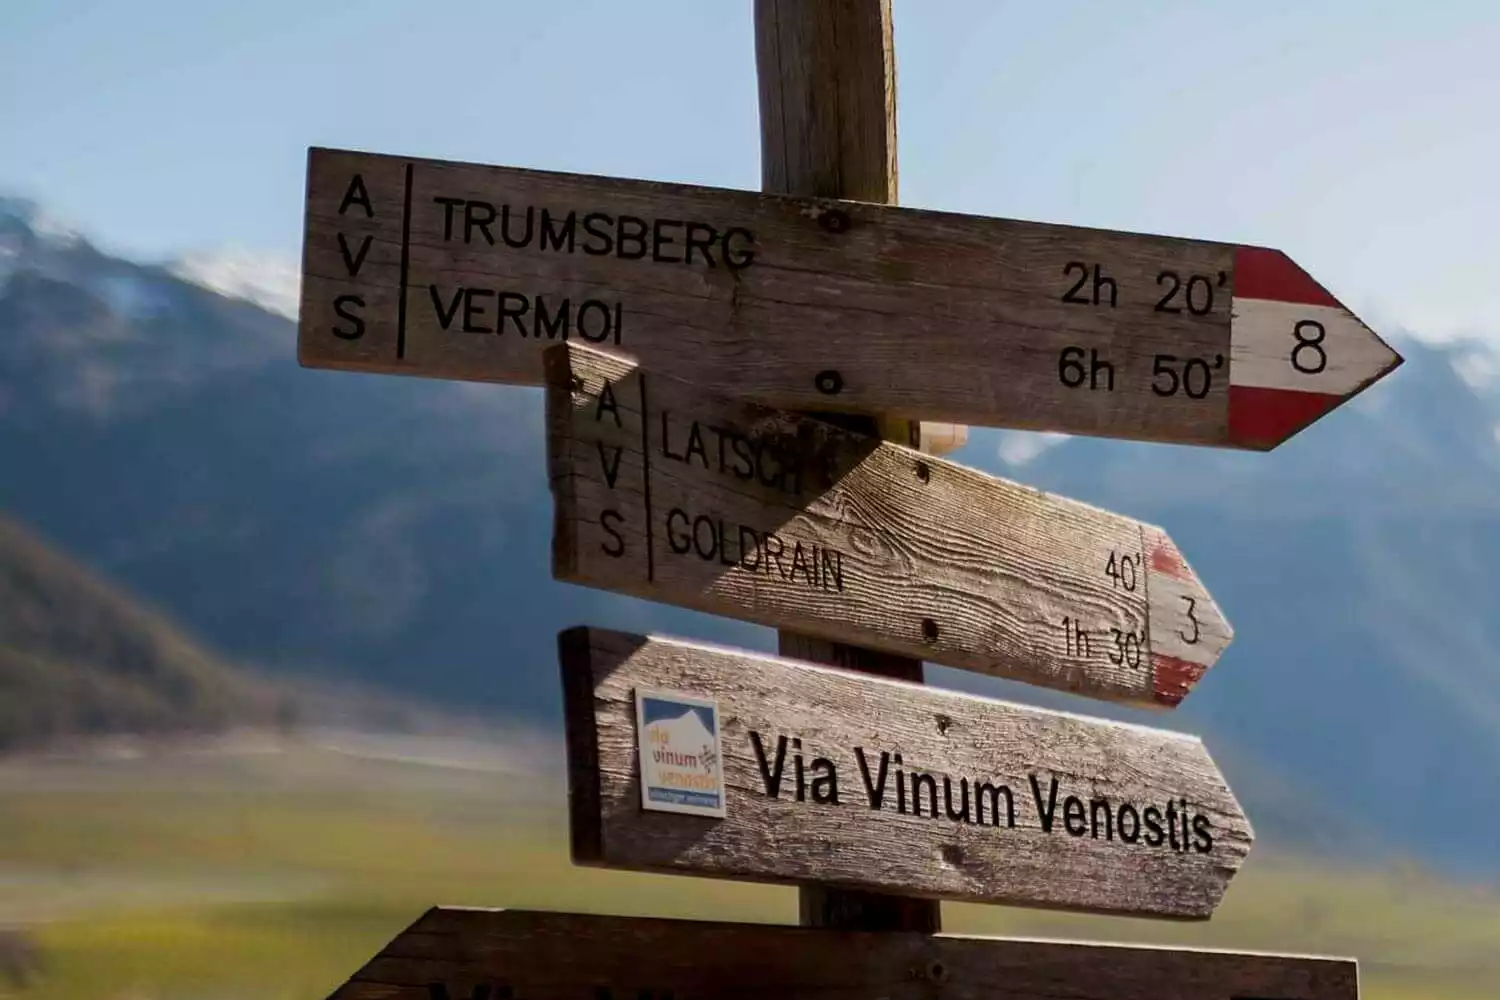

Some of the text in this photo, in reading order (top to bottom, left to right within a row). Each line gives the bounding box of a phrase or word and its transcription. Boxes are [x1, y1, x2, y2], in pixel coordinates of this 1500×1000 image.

[432, 196, 756, 270] TRUMSBERG
[428, 283, 623, 345] VERMOI
[1061, 262, 1227, 316] 2h 20'
[1057, 346, 1225, 400] 6h 50'
[1290, 319, 1328, 374] 8
[661, 409, 803, 496] LATSCH
[666, 506, 844, 594] GOLDRAIN
[1104, 550, 1142, 593] 40'
[1061, 615, 1090, 660] 1h
[1181, 597, 1200, 645] 3
[651, 745, 699, 769] vinum
[749, 730, 1215, 856] Via Vinum Venostis
